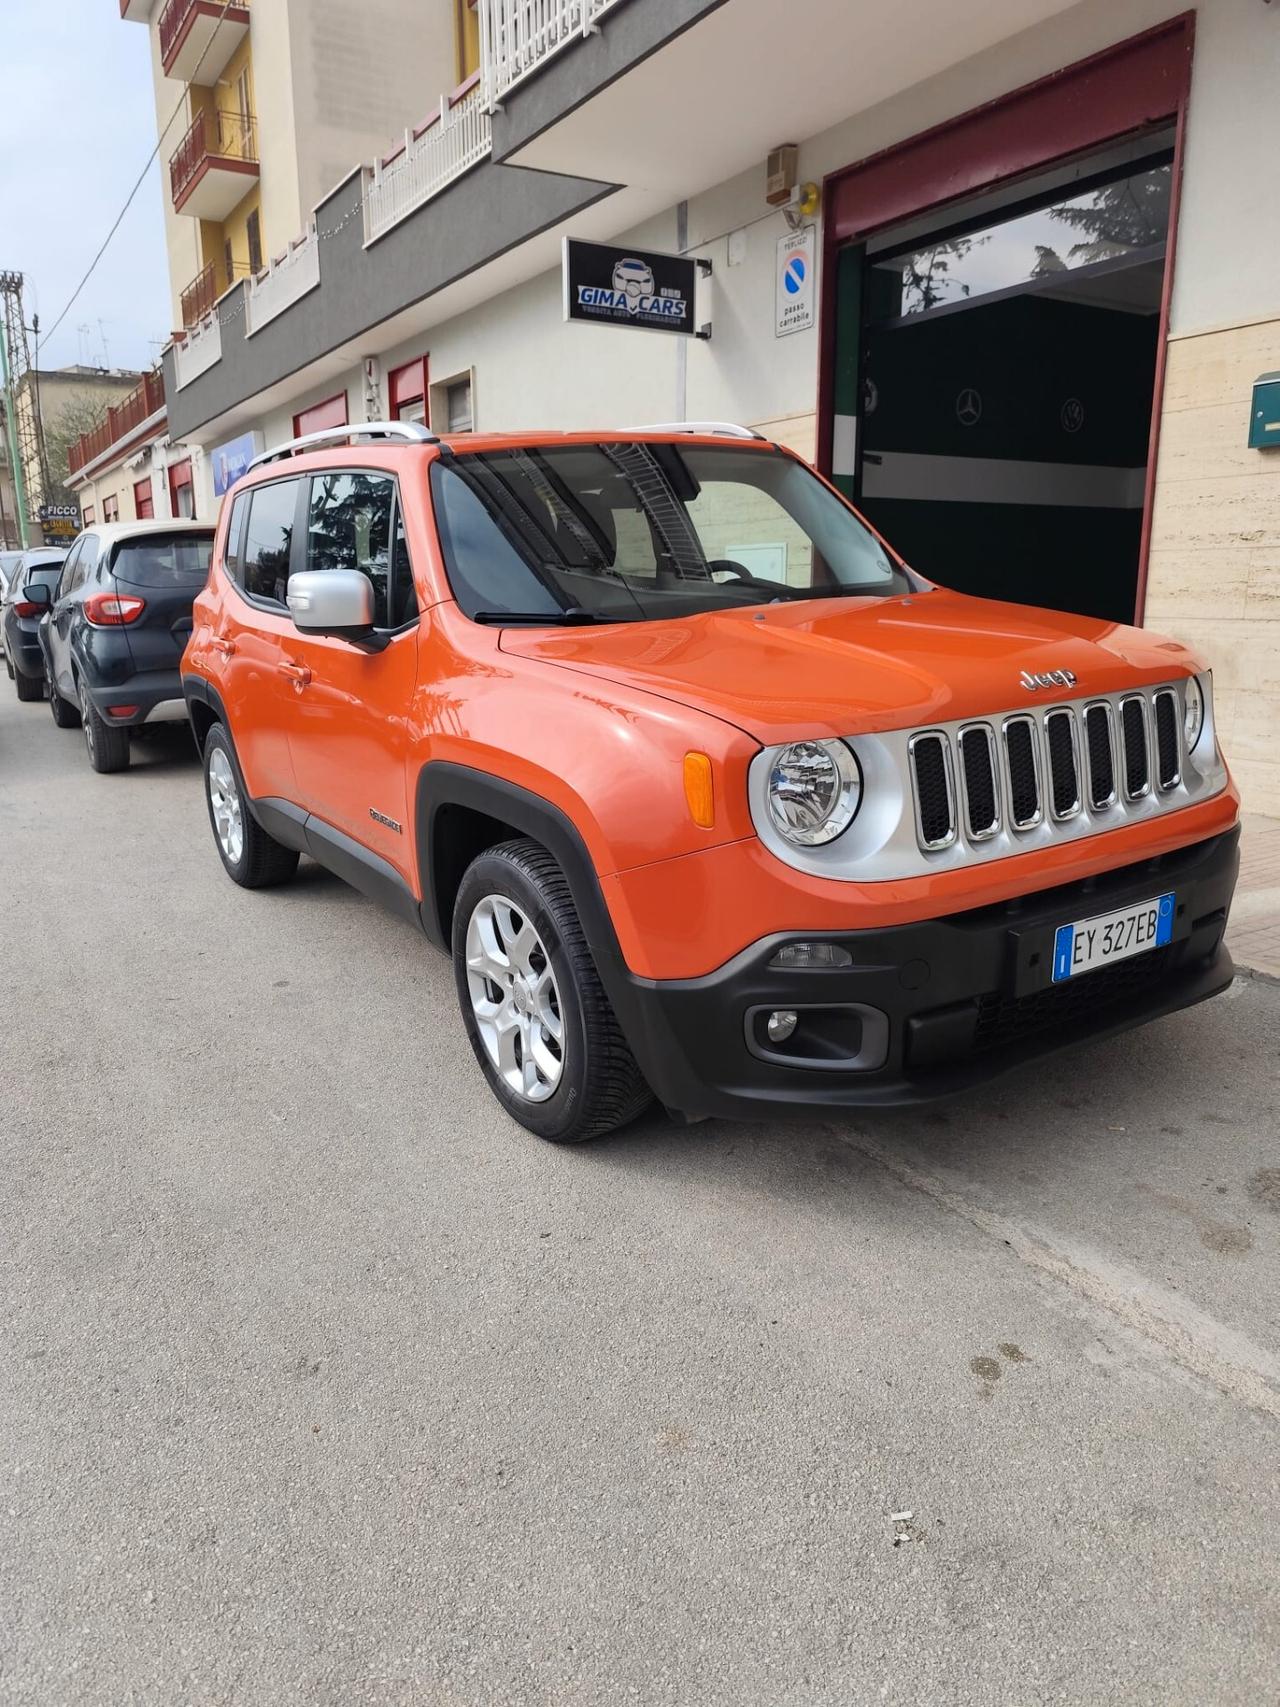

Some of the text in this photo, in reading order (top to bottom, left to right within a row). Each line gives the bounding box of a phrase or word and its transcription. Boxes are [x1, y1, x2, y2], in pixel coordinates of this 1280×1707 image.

[580, 287, 685, 316] GIMA CARS
[784, 303, 804, 316] passo
[779, 313, 809, 327] carrabile
[48, 506, 77, 515] FICCO
[1020, 670, 1076, 691] Jeep
[1073, 910, 1157, 965] EY 327EB
